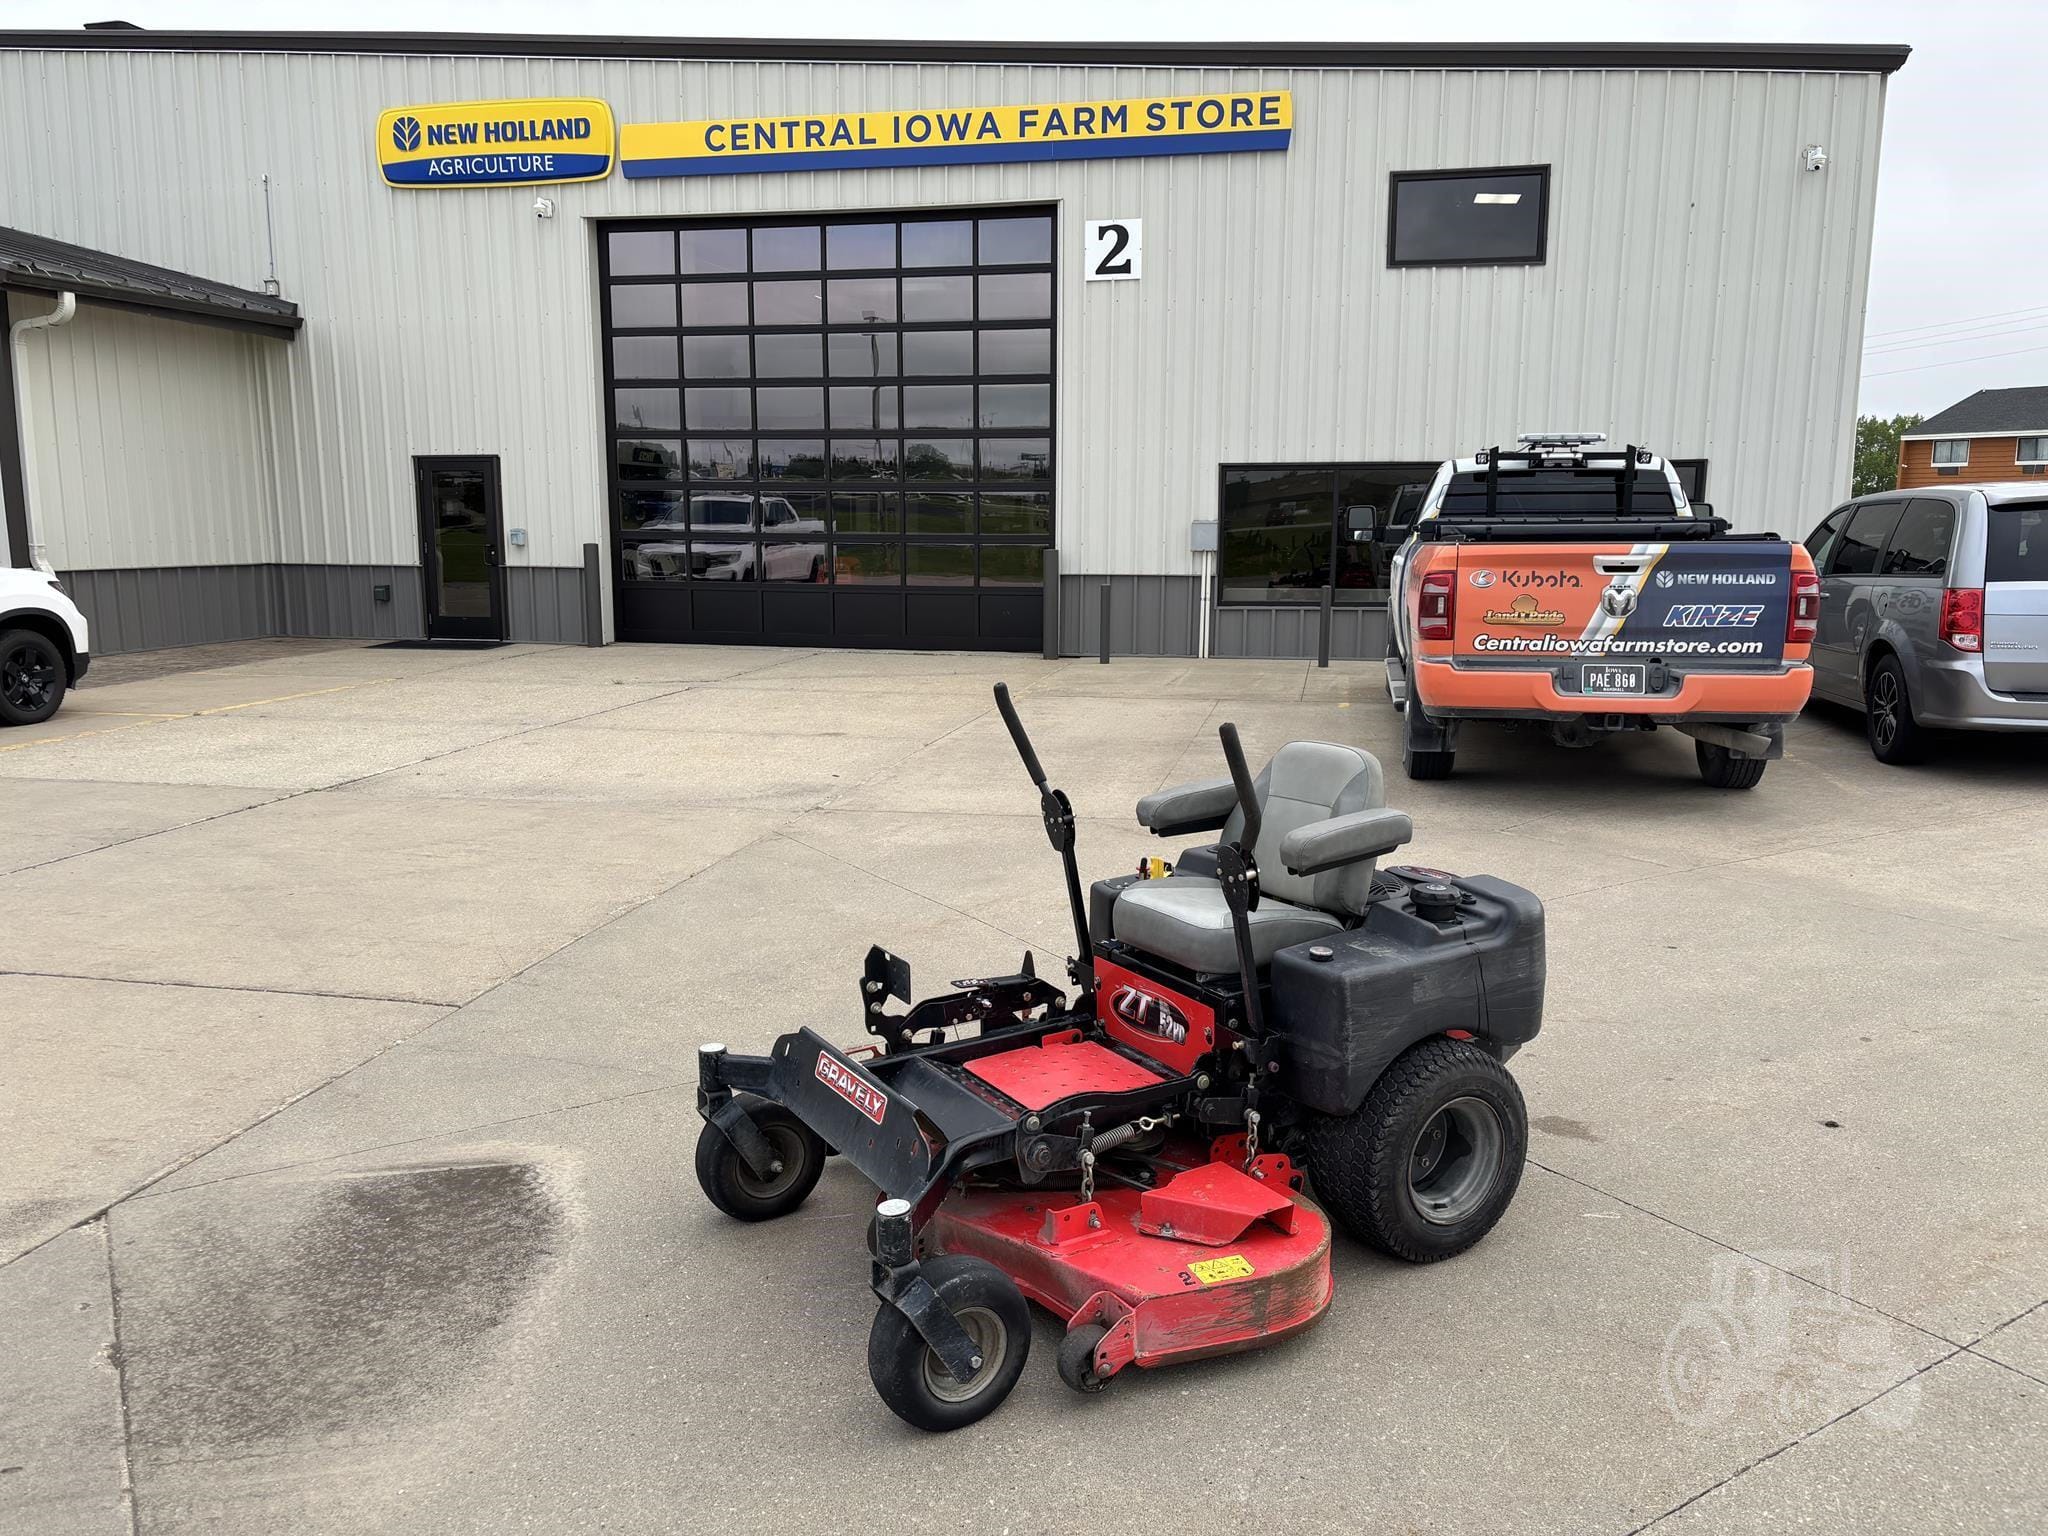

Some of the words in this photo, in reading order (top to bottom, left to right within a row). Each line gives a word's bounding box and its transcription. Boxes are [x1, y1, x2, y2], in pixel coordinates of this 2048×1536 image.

[427, 122, 478, 146] NEW
[483, 116, 591, 143] HOLLAND
[704, 117, 877, 152] CENTRAL
[893, 112, 1001, 144] IOWA
[1019, 105, 1128, 138] FARM
[1146, 96, 1281, 131] STORE
[428, 155, 554, 176] AGRICULTURE
[1095, 224, 1132, 275] 2
[1677, 574, 1709, 585] NEW
[1712, 574, 1776, 585] HOLLAND
[1662, 605, 1765, 627] KINZE
[1473, 633, 1764, 653] Centraliowafarmstore.com
[1590, 673, 1611, 687] PAE
[1614, 673, 1636, 688] 860
[1119, 984, 1152, 1024] ZT
[819, 1058, 884, 1115] GRAVELY
